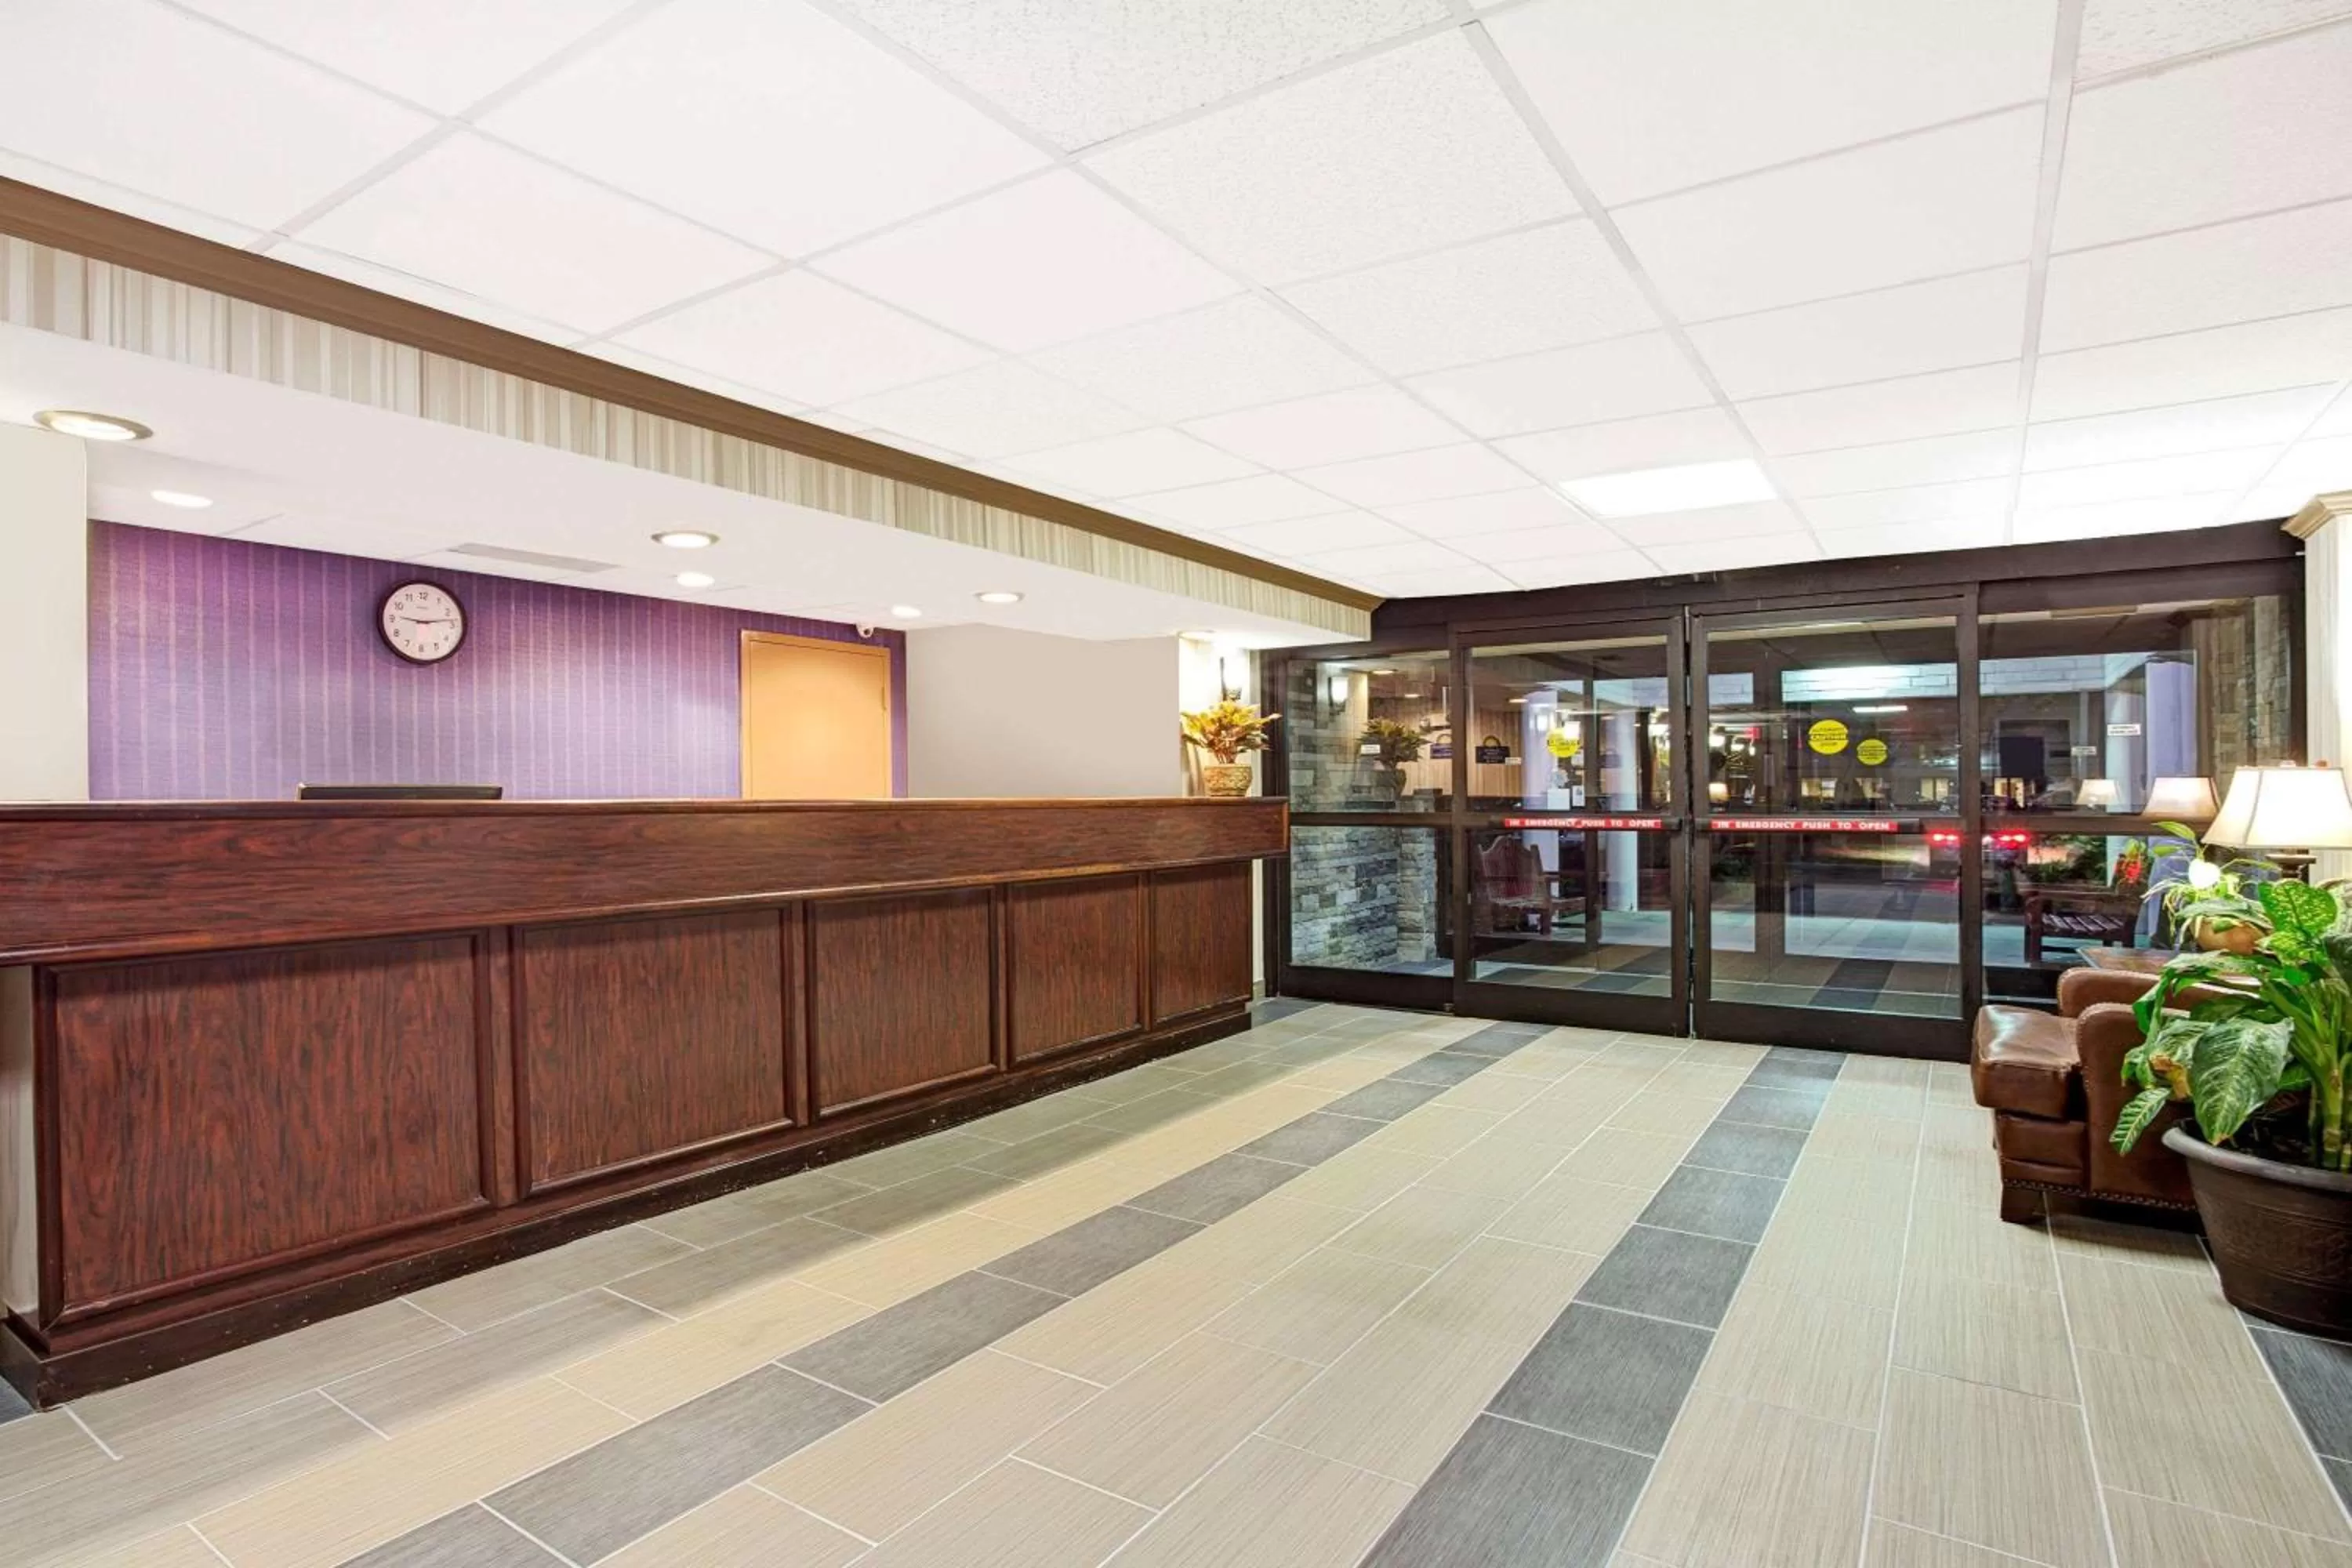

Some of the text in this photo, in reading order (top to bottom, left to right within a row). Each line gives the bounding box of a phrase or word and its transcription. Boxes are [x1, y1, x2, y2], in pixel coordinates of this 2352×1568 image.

[405, 593, 413, 602] 11
[418, 592, 429, 601] 12
[394, 601, 405, 611] 10
[445, 608, 451, 617] 2
[1509, 818, 1654, 828] IN EMERGENCY PUSH TO OPEN
[1718, 820, 1889, 830] IN EMERGENCY PUSH TO OPEN
